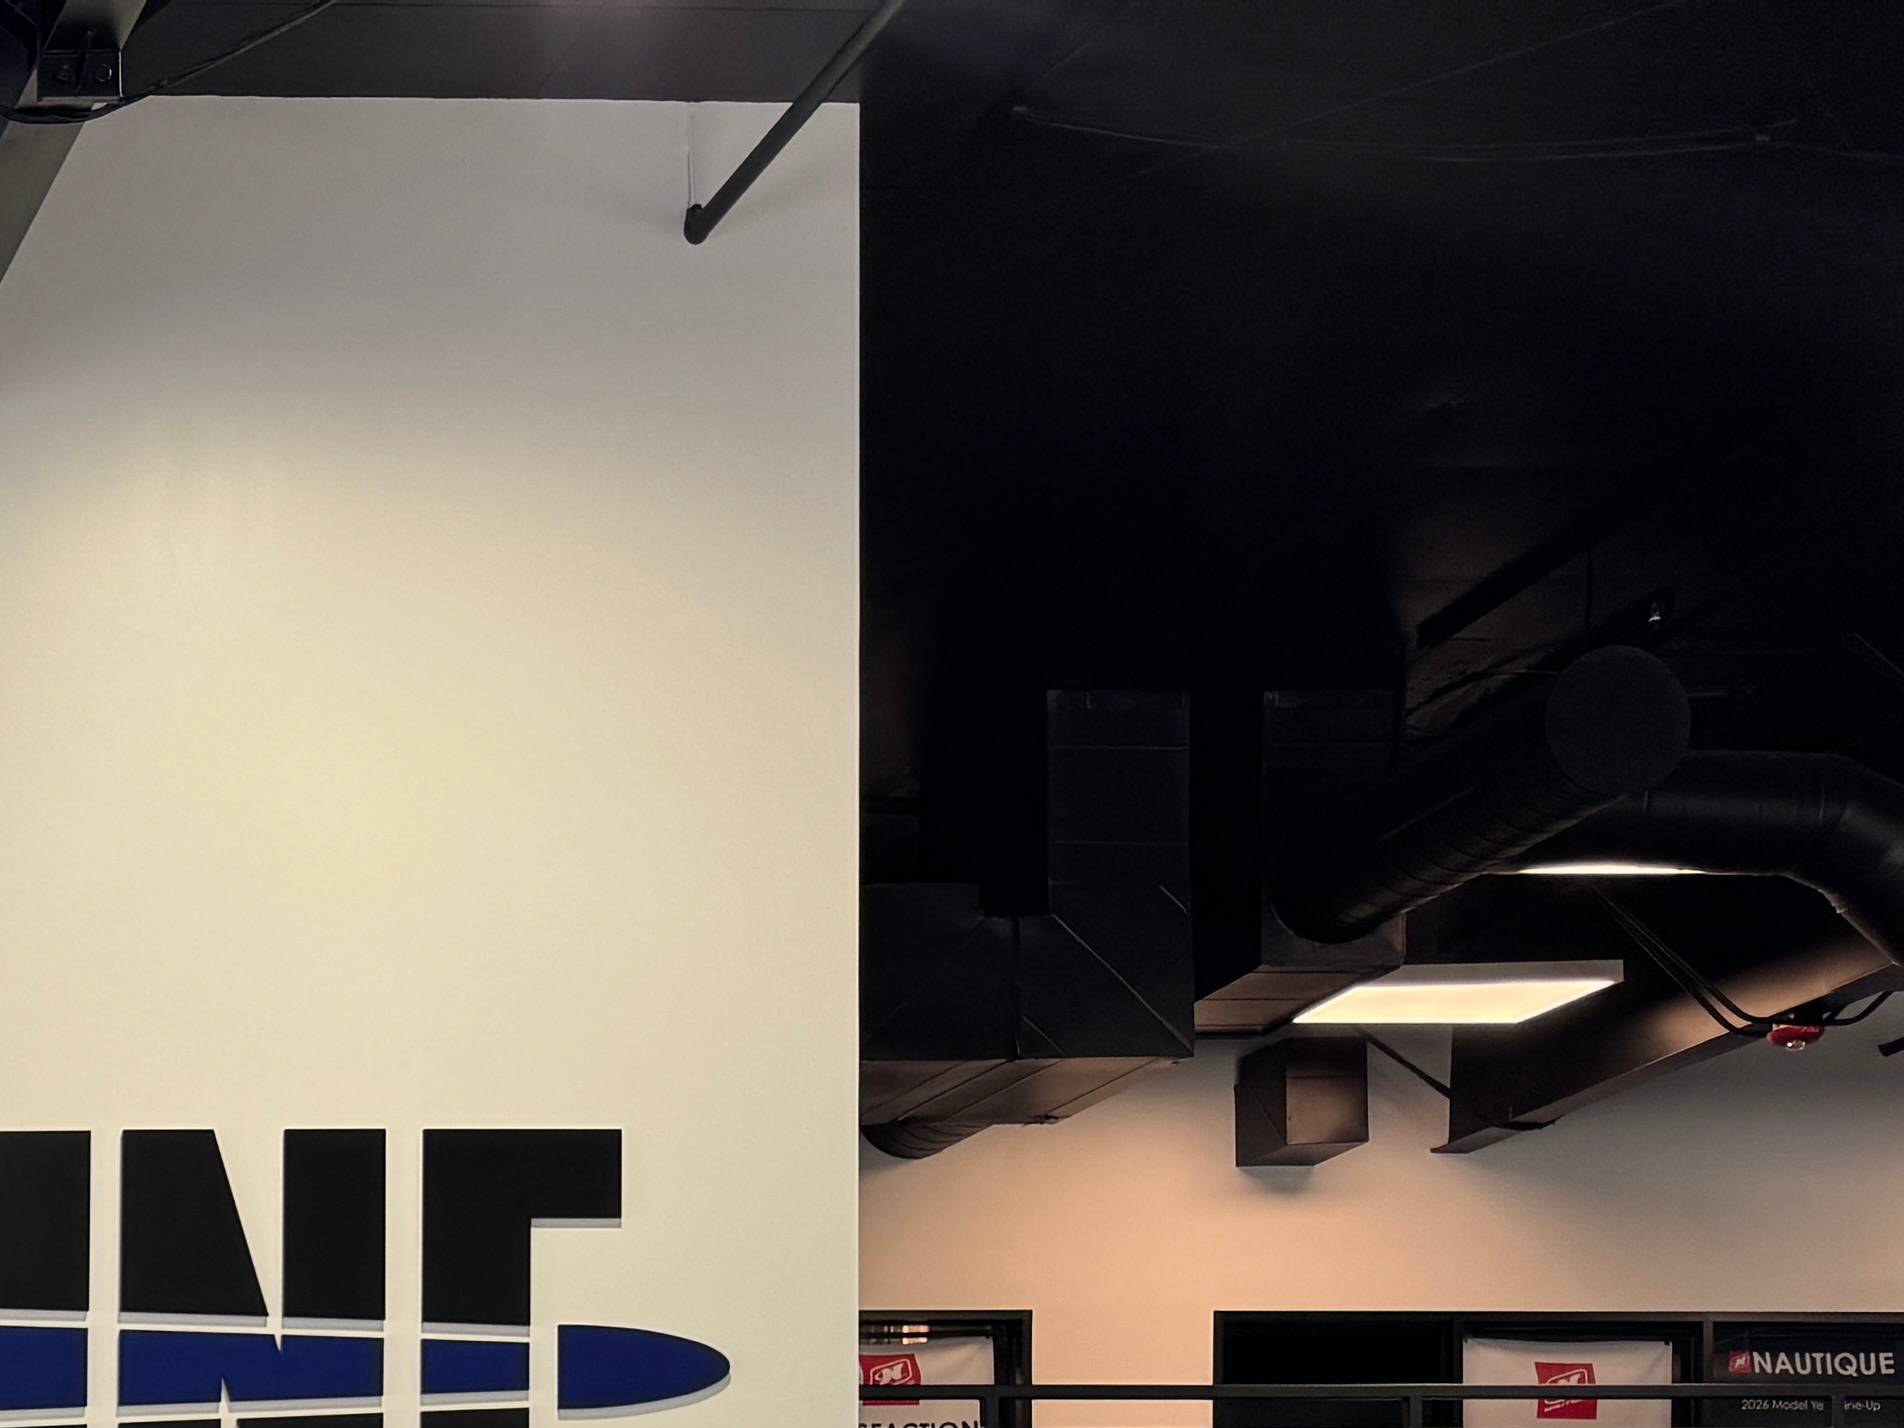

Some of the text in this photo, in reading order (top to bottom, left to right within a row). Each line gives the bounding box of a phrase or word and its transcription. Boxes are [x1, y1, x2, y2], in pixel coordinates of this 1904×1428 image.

[1752, 1351, 1896, 1377] NAUTIQUE
[1741, 1399, 1770, 1411] 2026
[1772, 1399, 1808, 1411] Model
[1844, 1401, 1881, 1411] ine-Up
